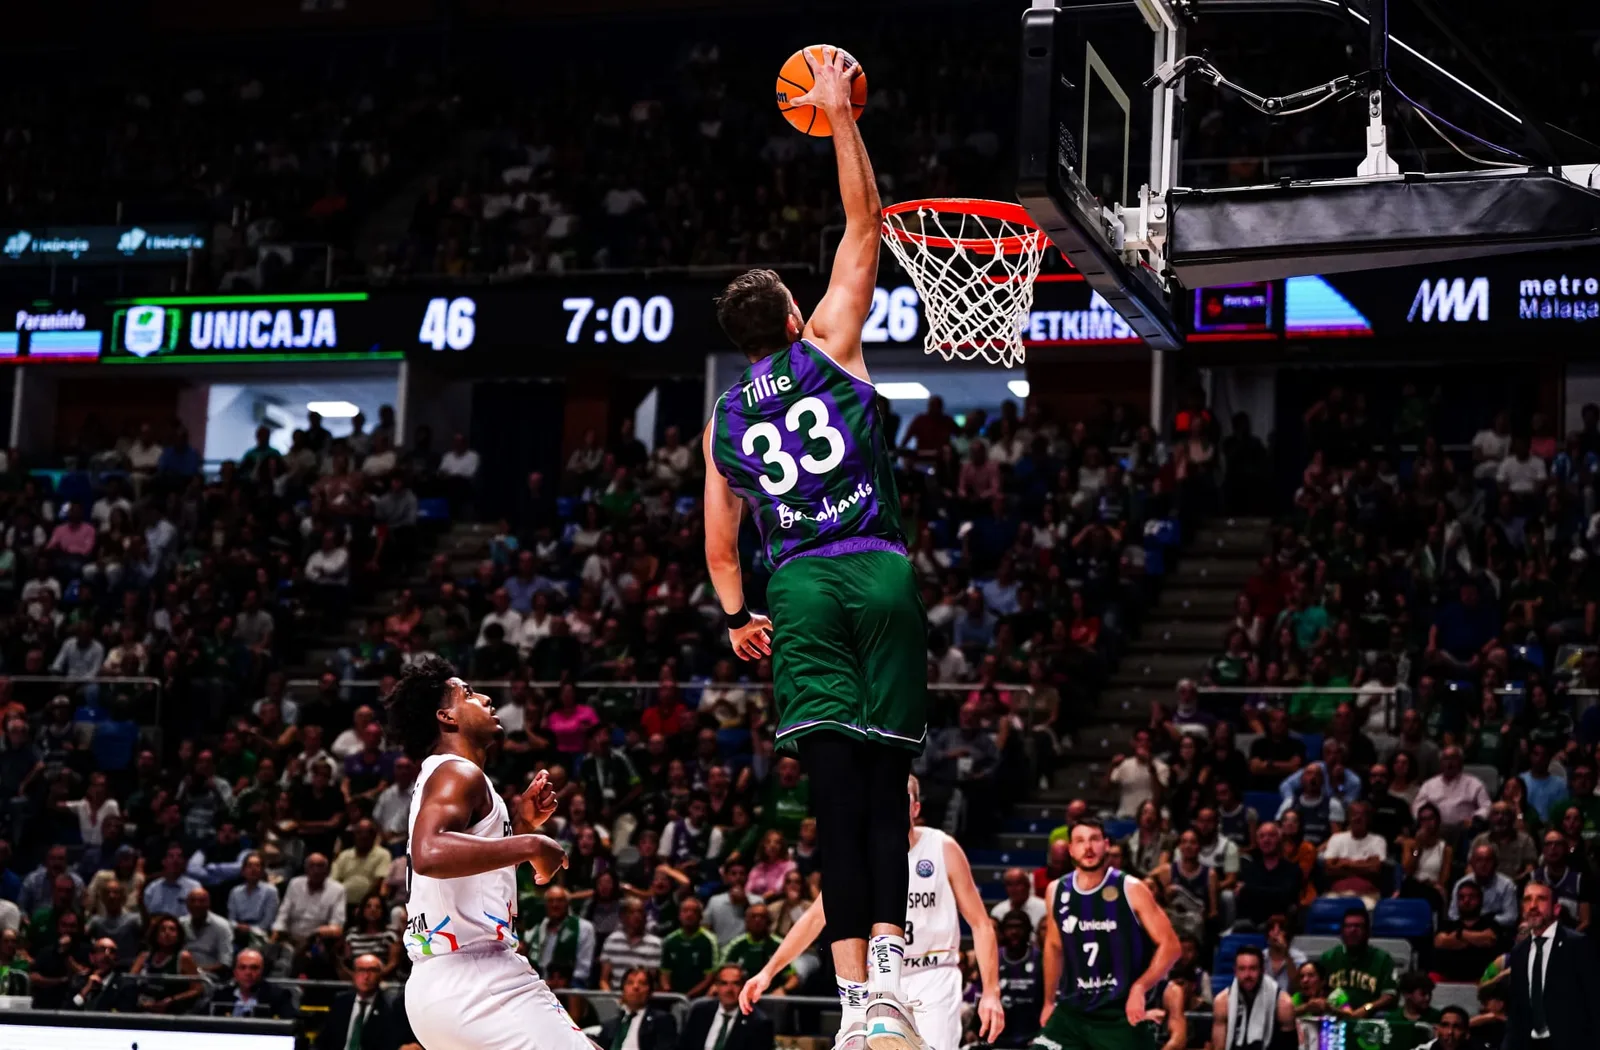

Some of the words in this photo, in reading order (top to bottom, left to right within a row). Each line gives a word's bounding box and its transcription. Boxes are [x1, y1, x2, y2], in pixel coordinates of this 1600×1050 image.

[1520, 274, 1599, 296] metro
[16, 309, 86, 330] Paraninfo
[190, 309, 338, 349] UNICAJA
[419, 297, 476, 350] 46
[562, 295, 674, 343] 7:00
[861, 286, 918, 342] 26
[1021, 310, 1139, 341] ETKIMS
[742, 374, 793, 408] Tillie
[742, 396, 846, 496] 33
[1078, 919, 1117, 932] Unicaja
[1083, 942, 1099, 967] 7
